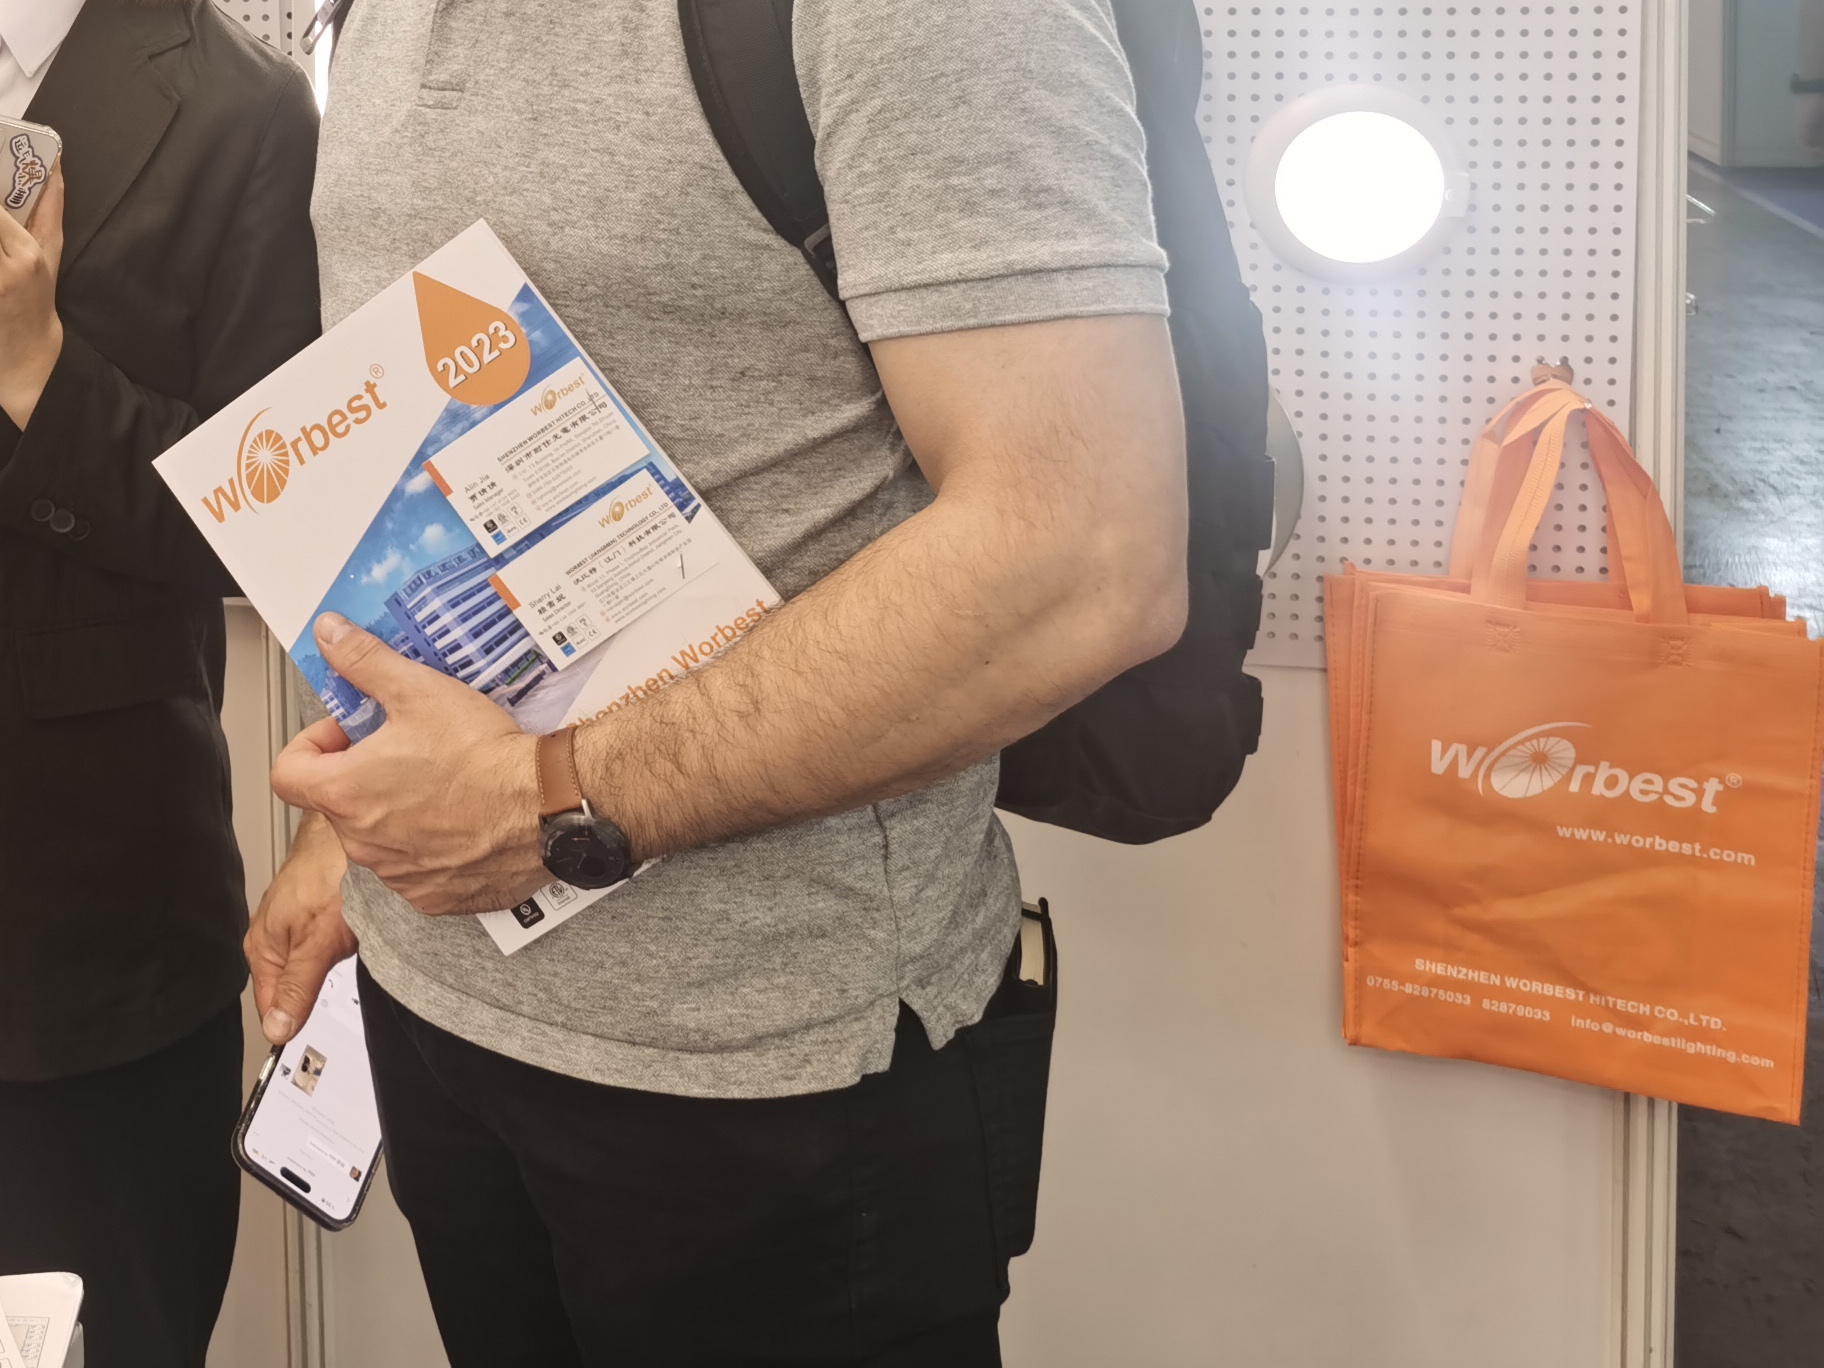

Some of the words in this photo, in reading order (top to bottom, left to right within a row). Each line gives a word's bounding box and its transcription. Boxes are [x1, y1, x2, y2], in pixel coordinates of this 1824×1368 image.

[436, 320, 517, 391] 2023
[529, 590, 551, 610] Sherry
[566, 667, 675, 728] henzhen
[671, 598, 772, 671] Worbest
[1556, 824, 1756, 867] www.worbest.com
[1414, 957, 1501, 987] SHENZHEN
[1504, 975, 1585, 1003] WORBEST
[1588, 992, 1651, 1016] HITECH
